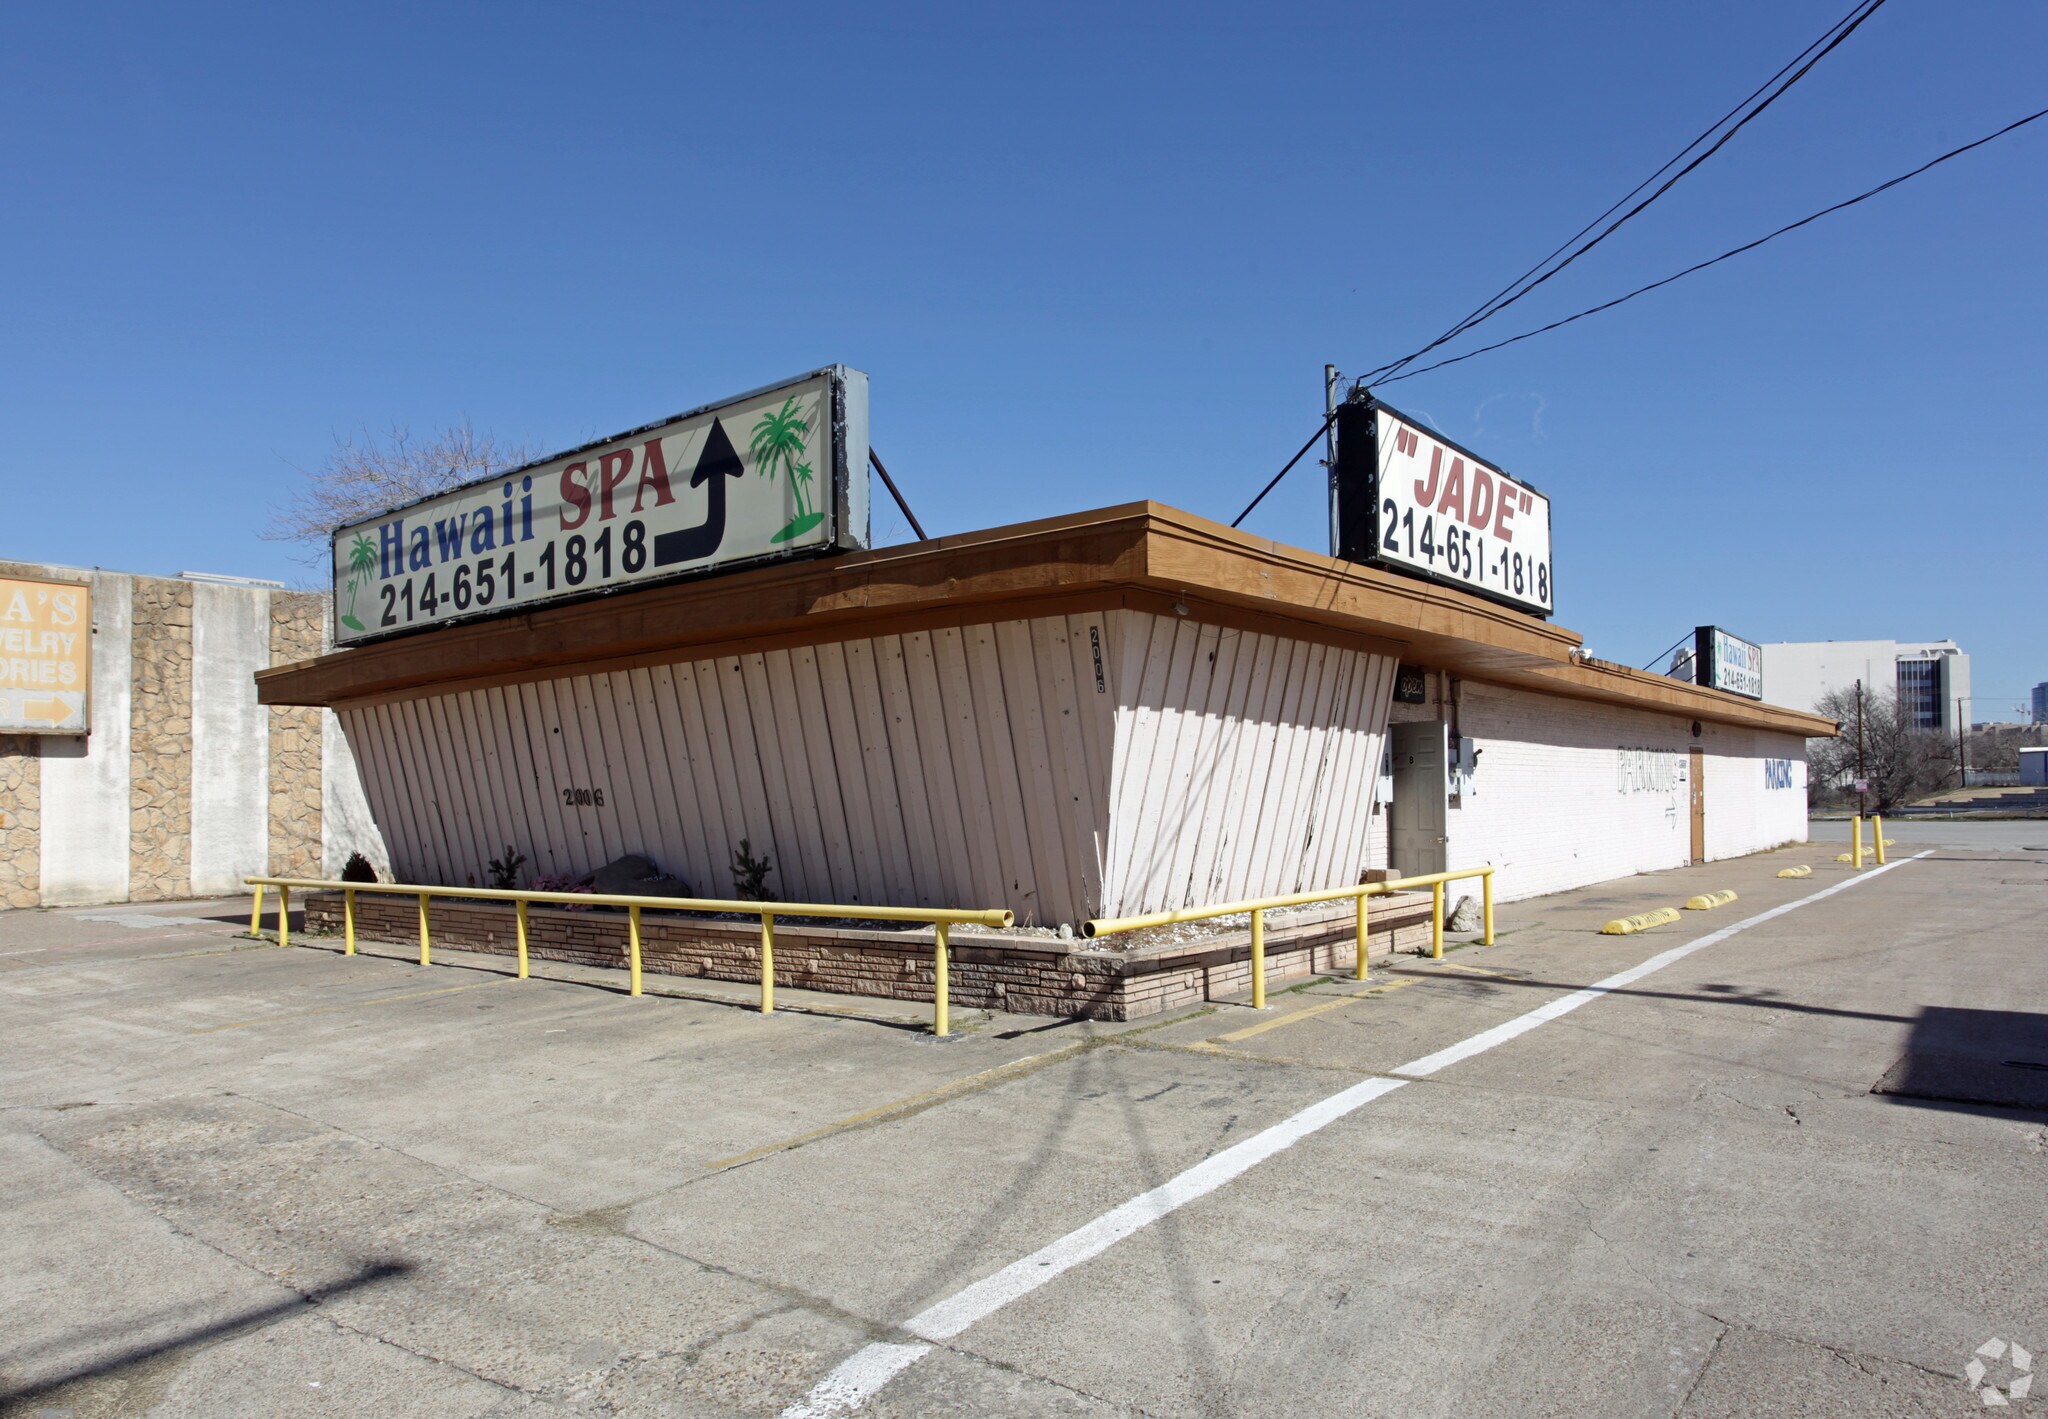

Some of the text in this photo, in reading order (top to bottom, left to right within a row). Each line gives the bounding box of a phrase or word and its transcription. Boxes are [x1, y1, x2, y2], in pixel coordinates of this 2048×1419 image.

[379, 437, 676, 580] Hawaii SPA
[380, 519, 647, 628] 214-651-1818
[1383, 497, 1548, 604] 214-651-1818
[0, 628, 77, 655] ELRY
[1090, 629, 1104, 693] 2006
[1723, 635, 1760, 674] Hawaii SPA
[1400, 675, 1424, 698] open
[1617, 745, 1678, 795] PARKING
[563, 788, 605, 807] 2006
